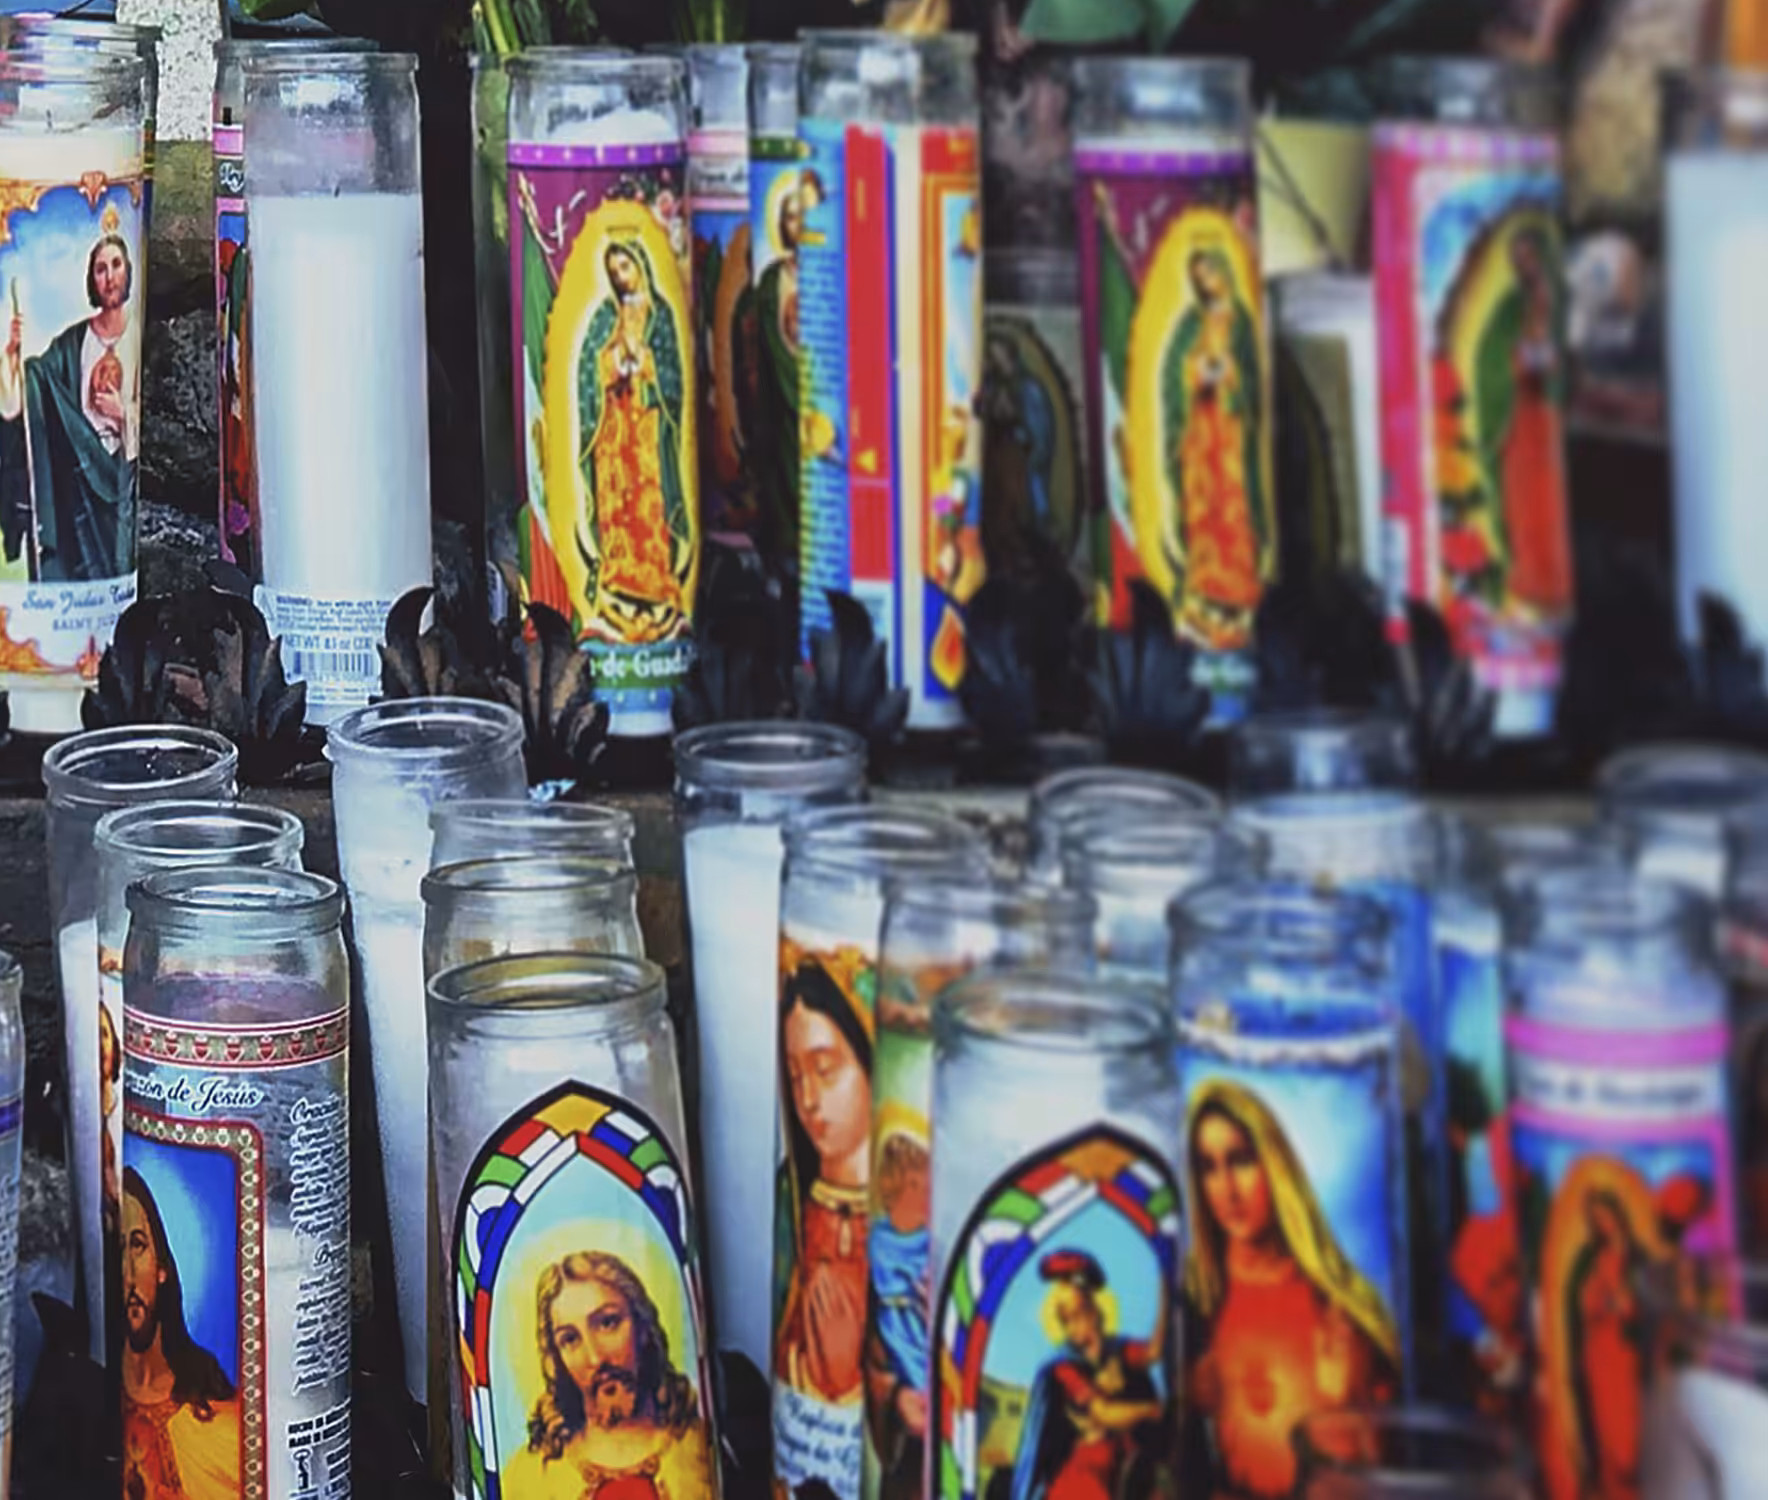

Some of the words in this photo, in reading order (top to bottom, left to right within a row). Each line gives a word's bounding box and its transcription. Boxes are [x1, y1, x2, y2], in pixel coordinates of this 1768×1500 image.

[22, 589, 55, 610] San
[59, 590, 104, 614] Judas
[52, 616, 92, 631] SAINT
[601, 649, 628, 679] de
[166, 1075, 192, 1103] de
[191, 1077, 263, 1112] Jesús
